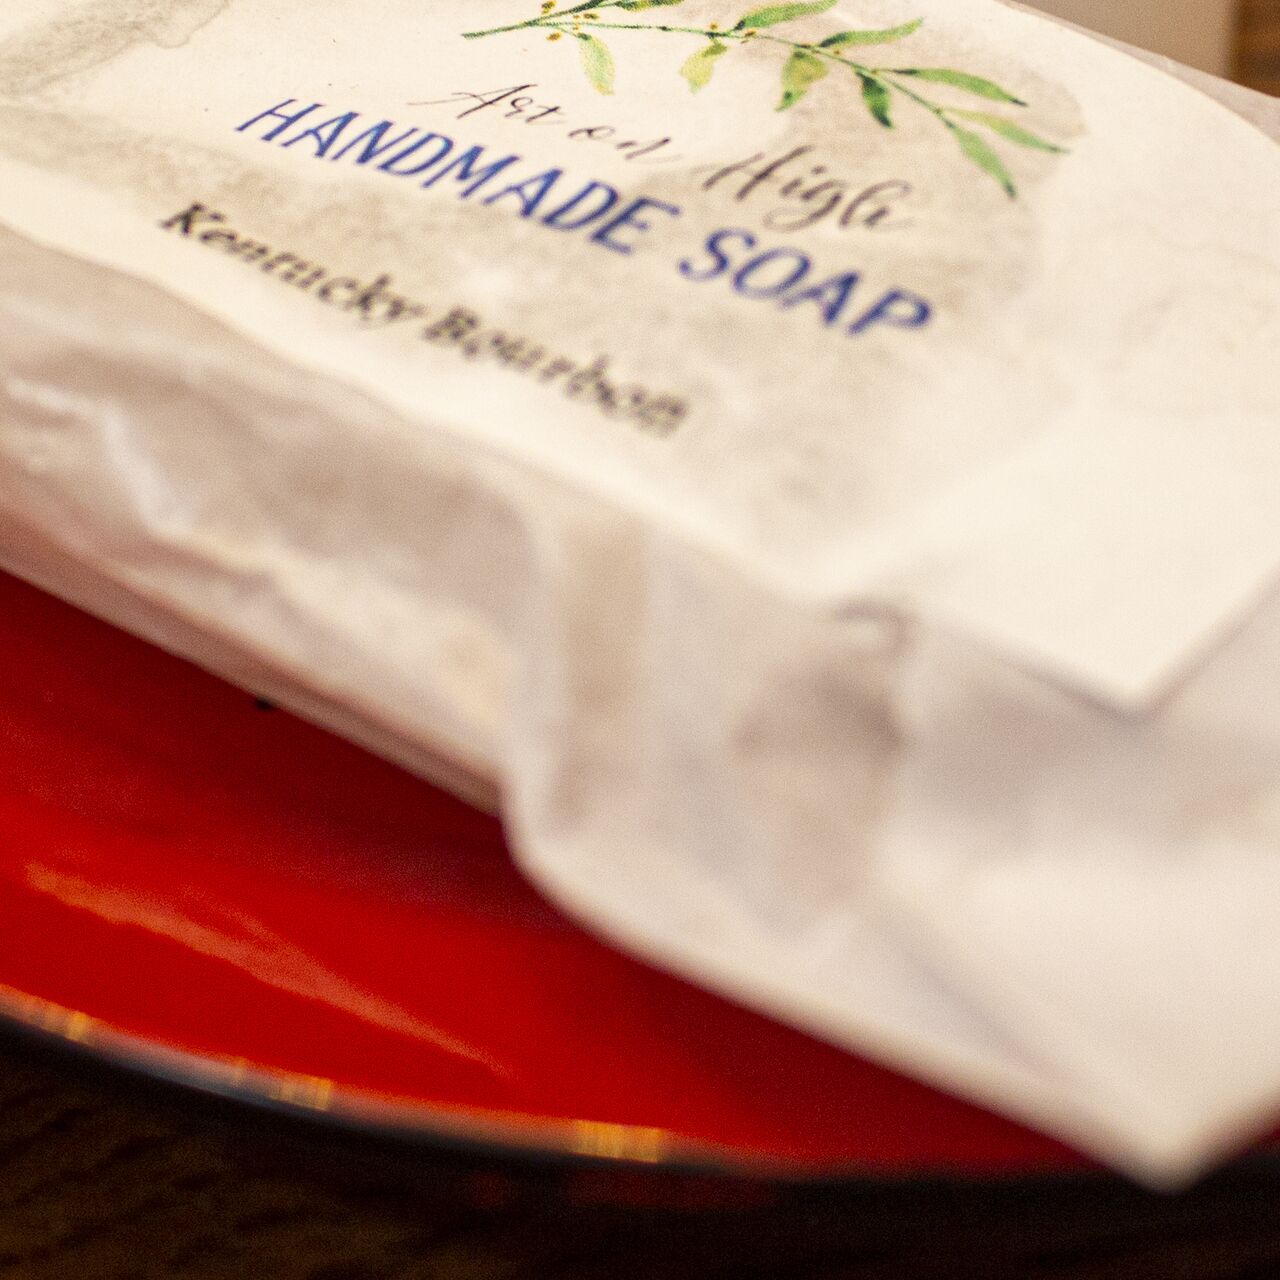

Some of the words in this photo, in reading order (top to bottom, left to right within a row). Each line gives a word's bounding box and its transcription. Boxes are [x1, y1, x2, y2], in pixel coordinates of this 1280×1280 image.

[234, 97, 682, 256] HANDMADE
[677, 227, 934, 338] SOAP
[692, 144, 914, 233] High
[160, 200, 428, 328] Kentucky
[422, 305, 692, 436] Bourbon
